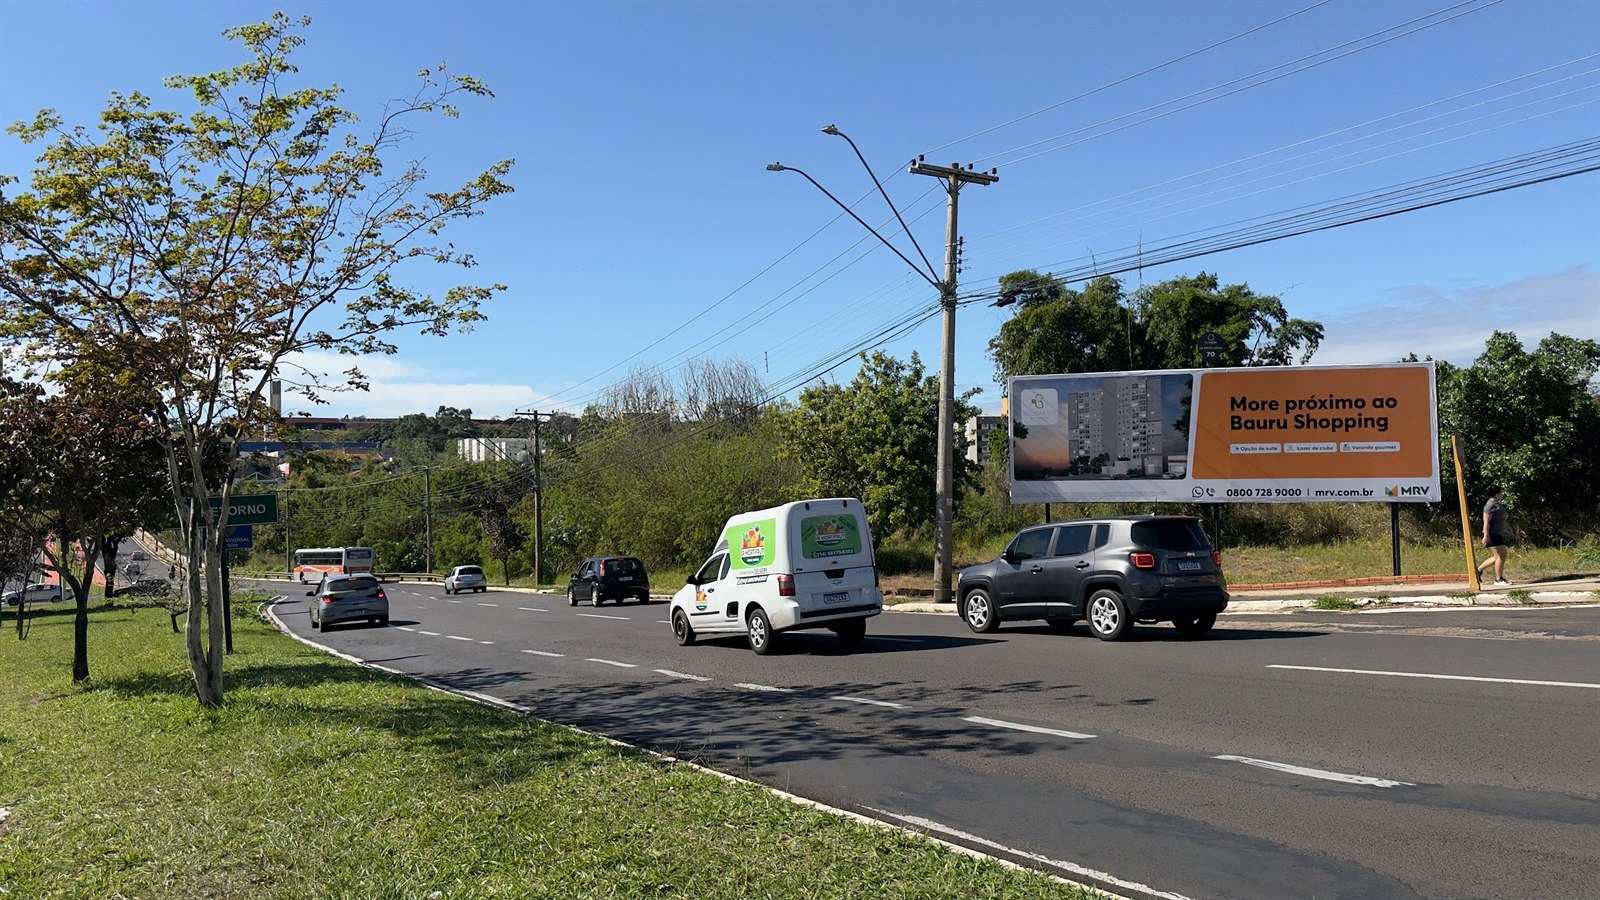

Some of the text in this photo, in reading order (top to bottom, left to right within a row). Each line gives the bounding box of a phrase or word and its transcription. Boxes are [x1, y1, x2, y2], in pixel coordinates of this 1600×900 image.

[1230, 394, 1398, 414] More próximo ao
[1230, 413, 1389, 432] Bauru Shopping
[1226, 487, 1374, 497] 0800 728 9000 mrv.com.br
[1401, 486, 1430, 496] MRV
[202, 504, 266, 517] EORNO
